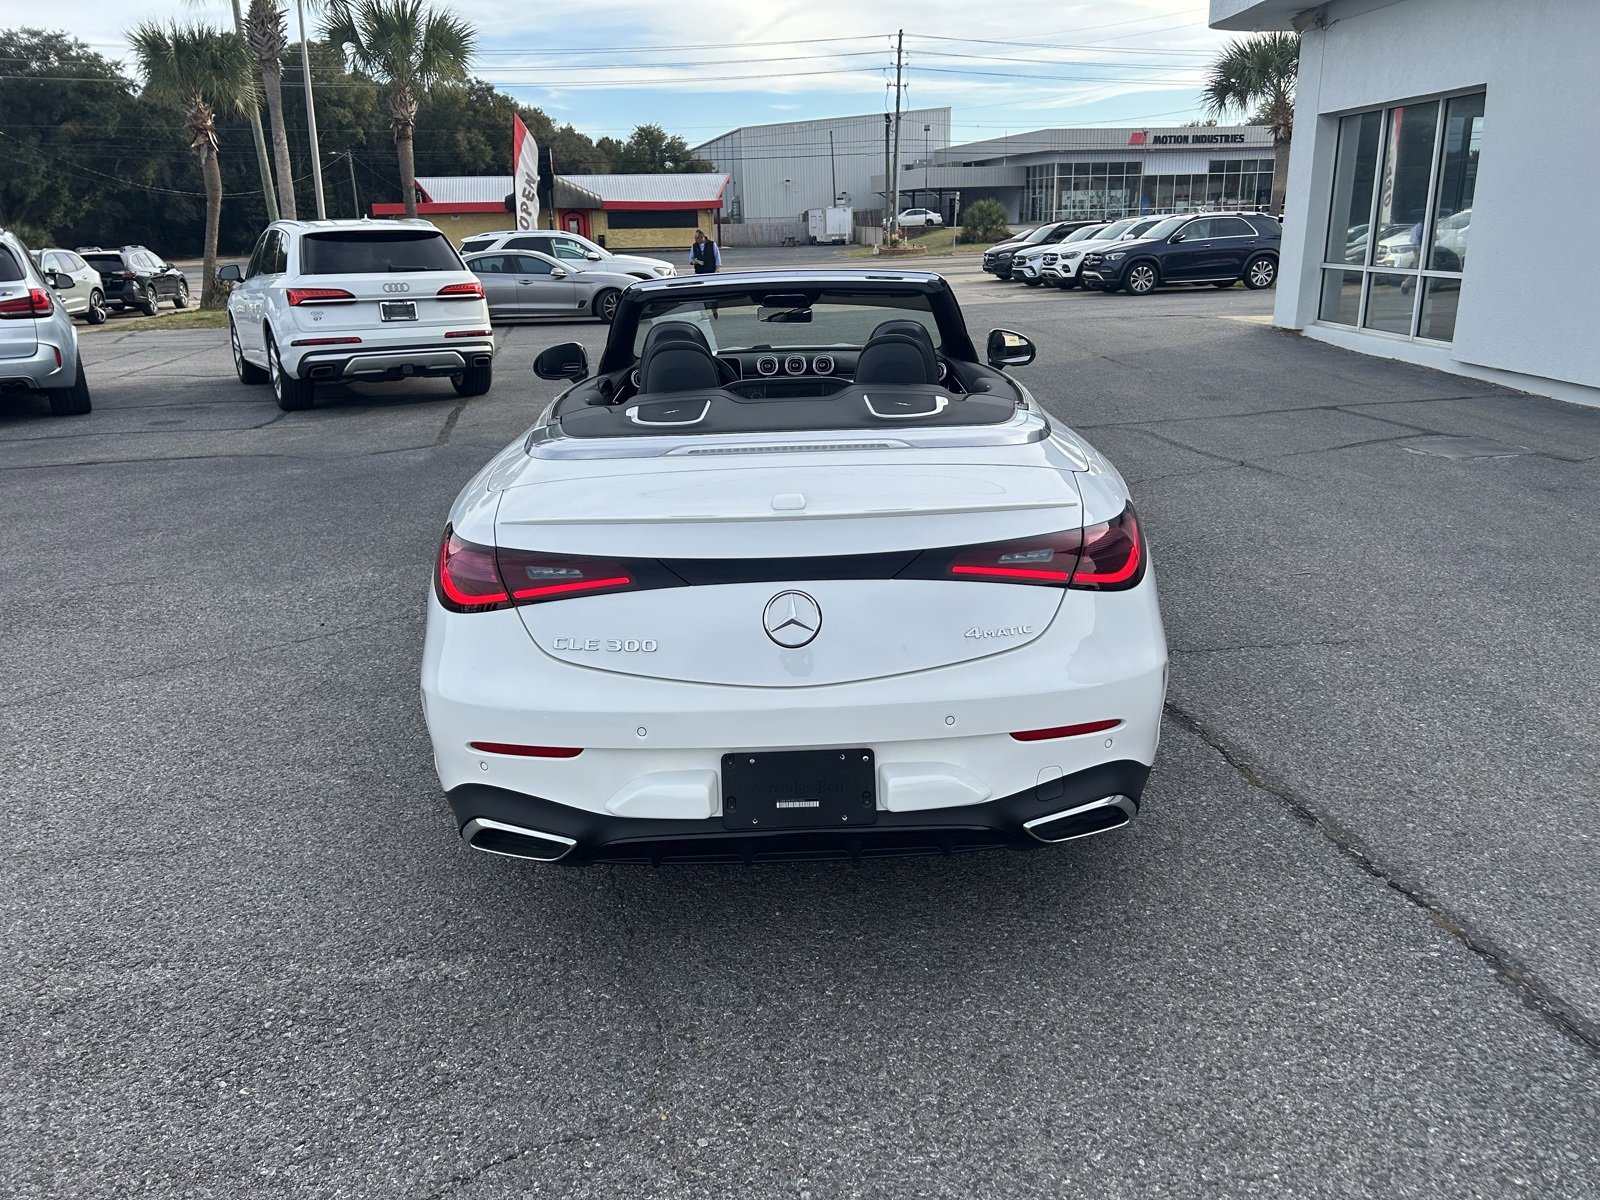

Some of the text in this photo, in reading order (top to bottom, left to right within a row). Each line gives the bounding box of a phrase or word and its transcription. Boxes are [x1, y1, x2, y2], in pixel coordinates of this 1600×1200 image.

[1152, 133, 1245, 145] MOTION INDUSTRIES
[518, 171, 537, 231] OPEN
[553, 637, 658, 652] CLE 300
